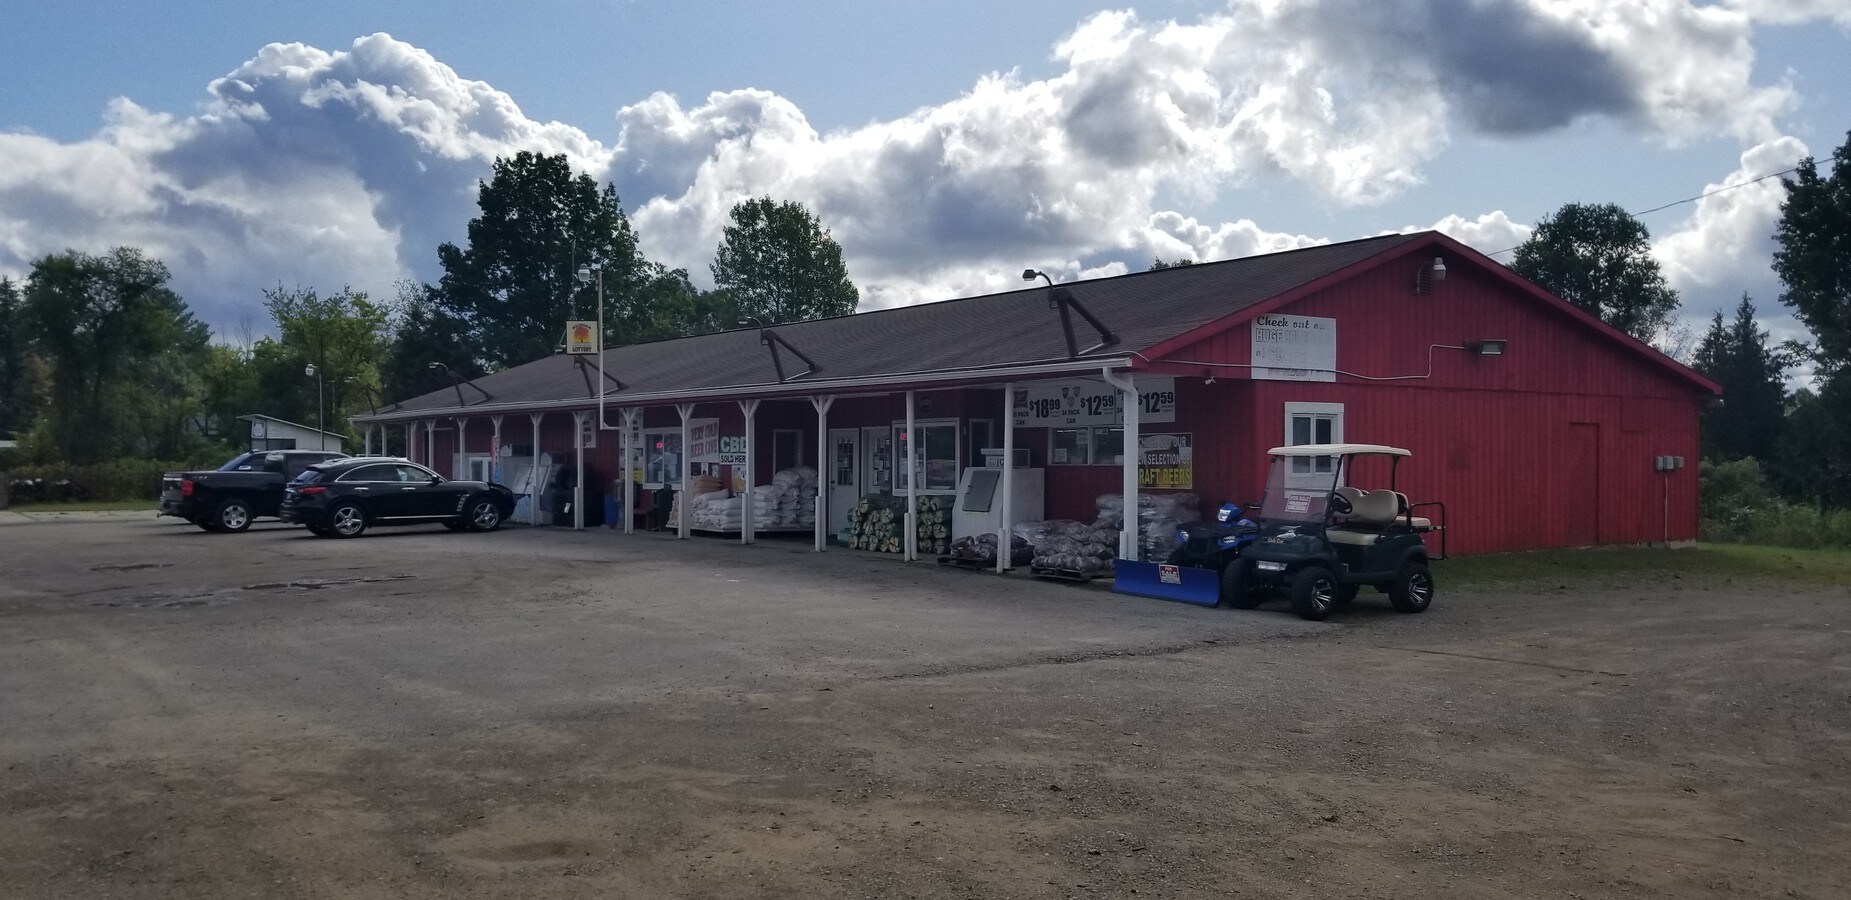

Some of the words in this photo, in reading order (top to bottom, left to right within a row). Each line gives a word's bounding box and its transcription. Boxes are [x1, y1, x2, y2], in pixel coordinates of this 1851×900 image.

[1257, 316, 1288, 327] Check
[1293, 320, 1310, 329] out
[691, 426, 704, 441] VERY
[705, 423, 718, 438] COLD
[1173, 437, 1187, 447] OUR
[691, 443, 704, 458] BEER
[721, 455, 734, 463] SOLD
[735, 454, 746, 462] HER
[996, 458, 1004, 466] IC
[1148, 454, 1180, 465] SELECTION
[1139, 469, 1160, 484] RAFT
[1163, 469, 1190, 485] BEERS
